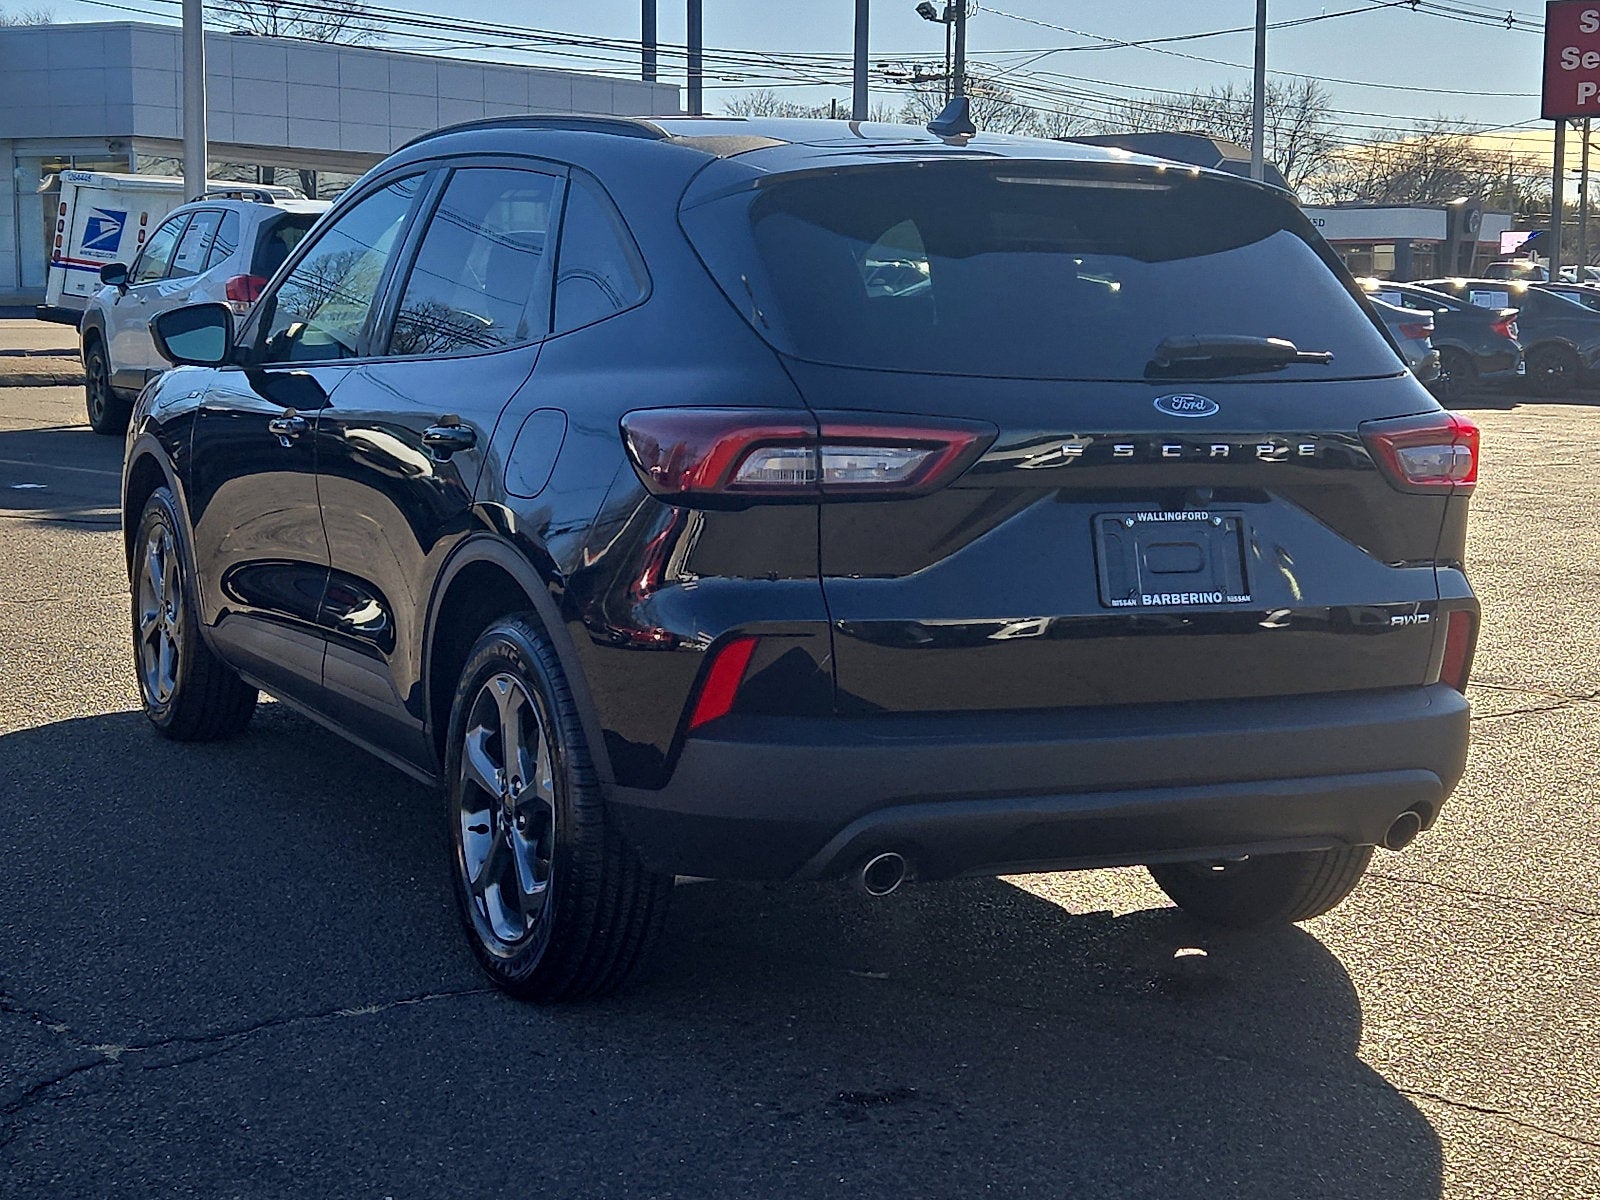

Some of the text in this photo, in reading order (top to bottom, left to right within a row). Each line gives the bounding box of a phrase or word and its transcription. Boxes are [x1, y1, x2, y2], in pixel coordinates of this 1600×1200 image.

[1577, 81, 1600, 106] P
[1062, 444, 1316, 457] ESCAPE
[1137, 511, 1209, 522] WALLINGFORD
[1111, 592, 1252, 607] NISSAN BARBERINO NISSAN
[1390, 613, 1430, 626] AWD
